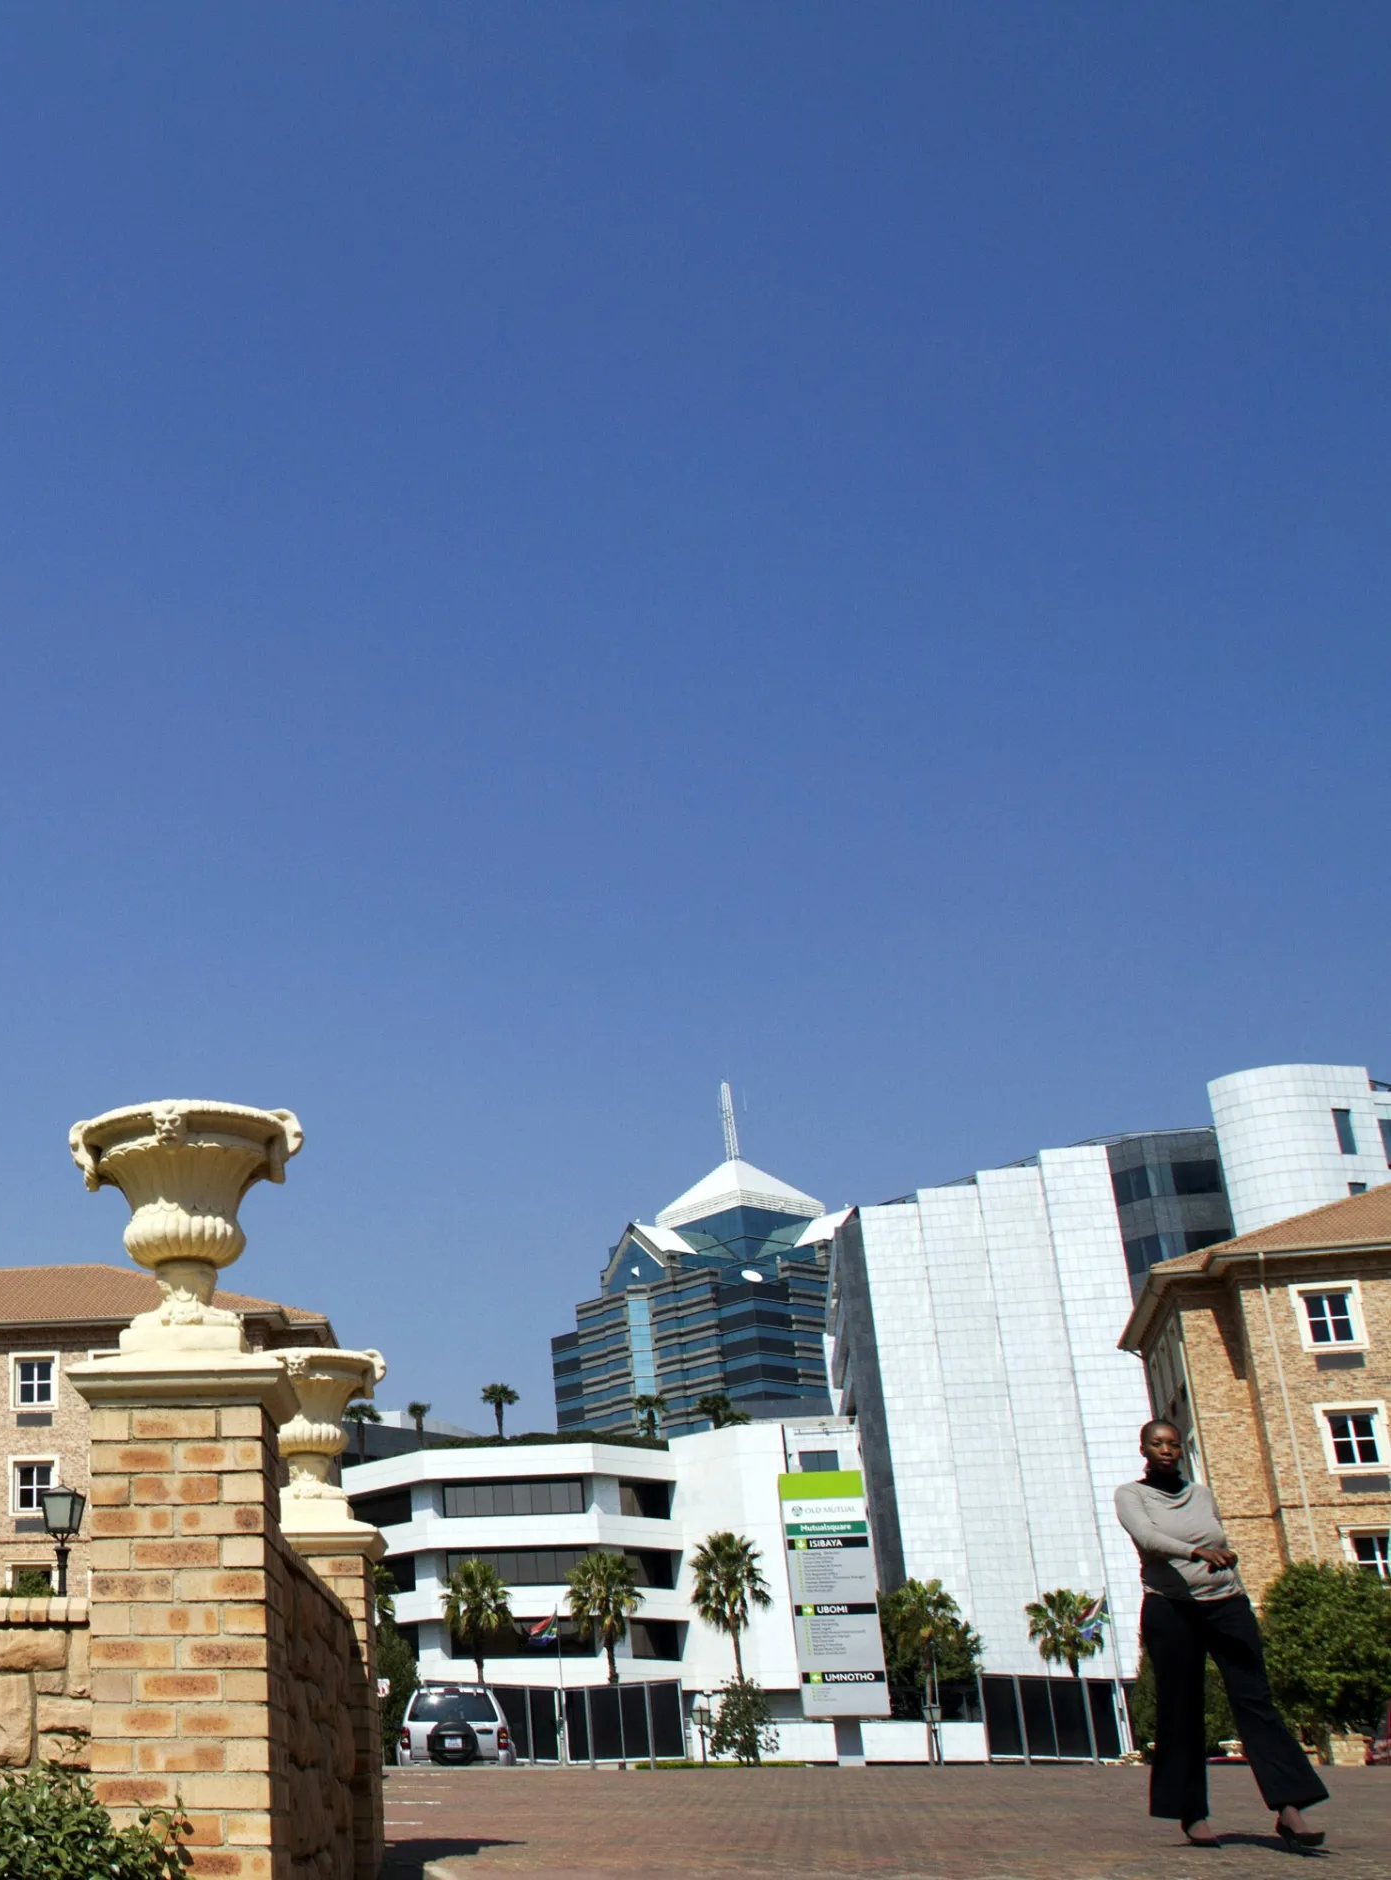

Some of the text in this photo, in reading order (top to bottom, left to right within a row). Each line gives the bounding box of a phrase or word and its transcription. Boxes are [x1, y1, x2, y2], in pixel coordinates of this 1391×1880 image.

[823, 1505, 856, 1513] MUTUAL
[800, 1523, 851, 1532] Mutualsquare
[809, 1539, 843, 1547] ISIBAYA
[816, 1605, 848, 1613] UBOMI
[824, 1673, 874, 1681] UMNOTHO
